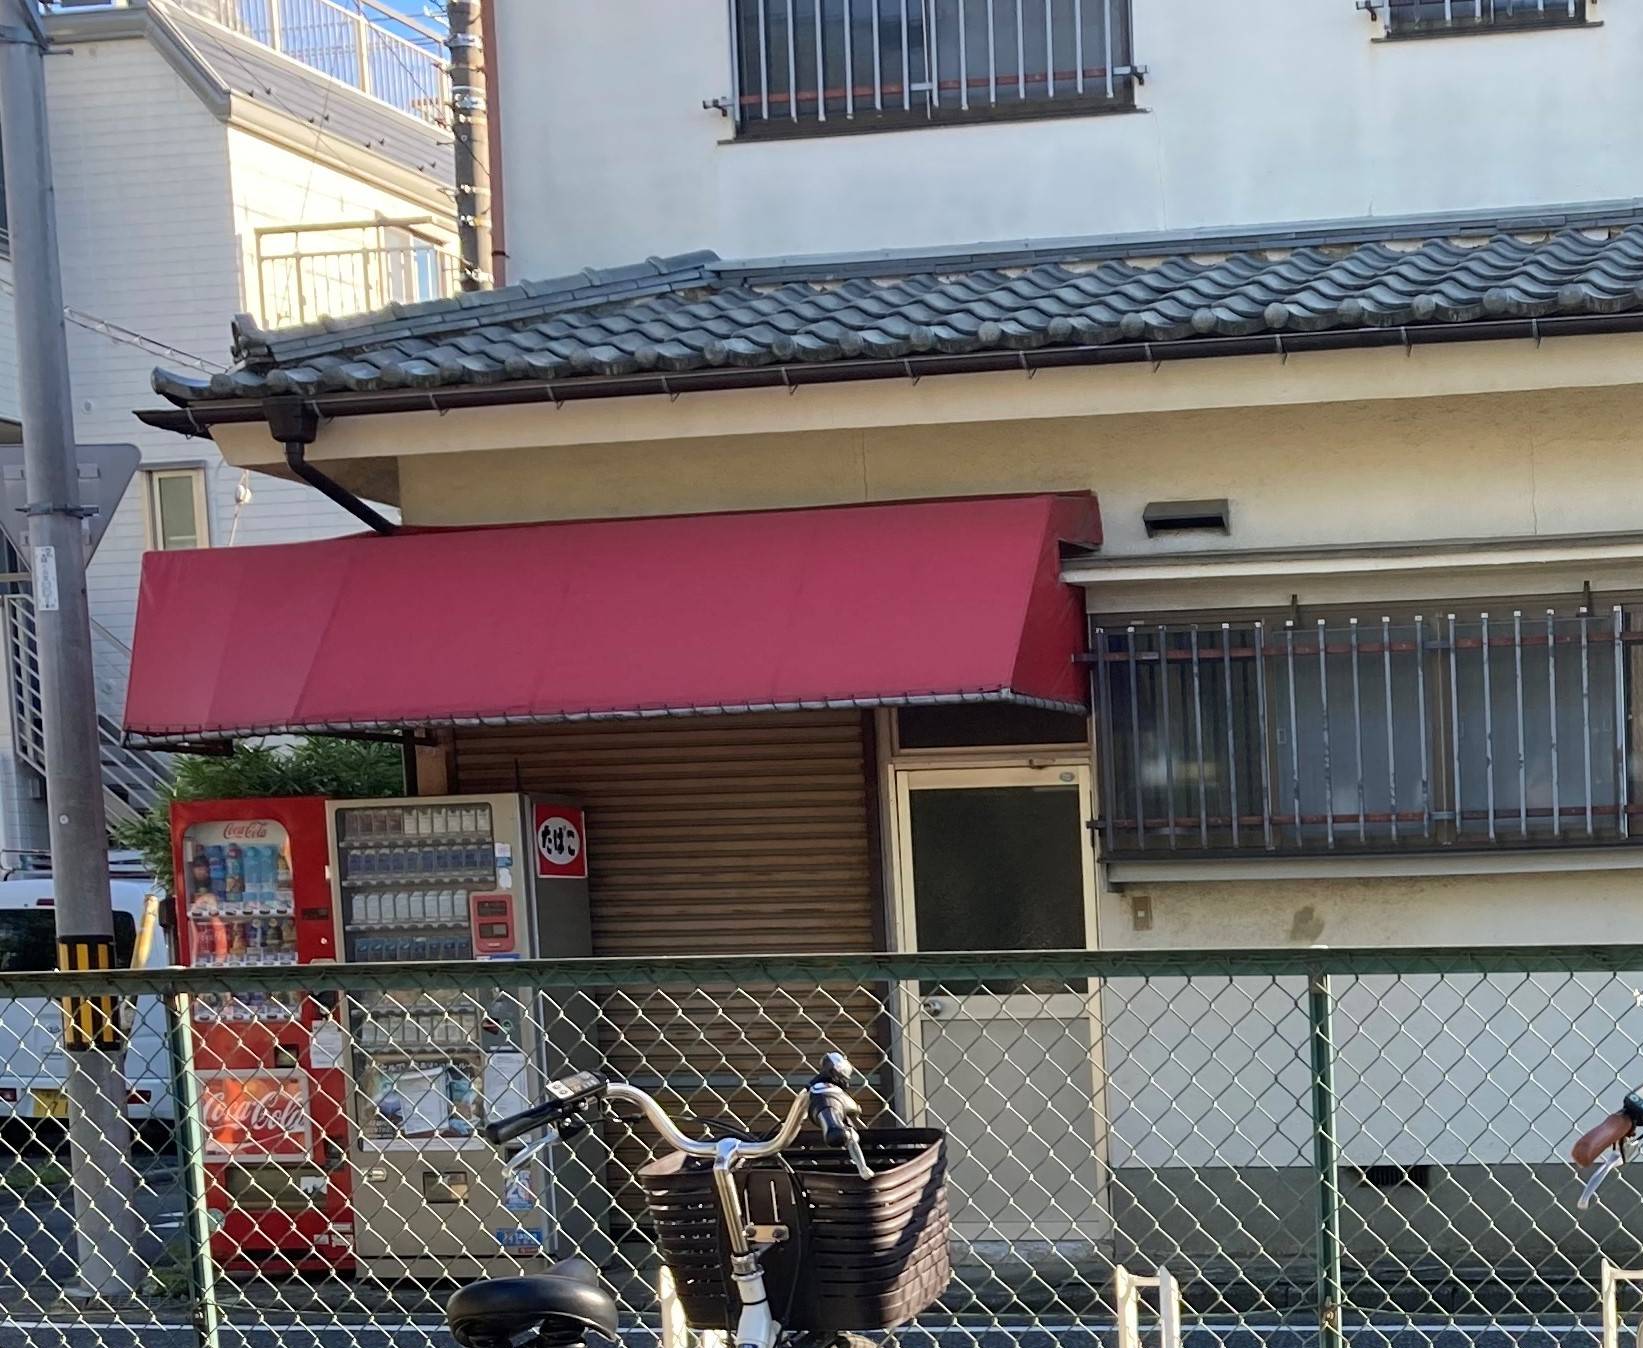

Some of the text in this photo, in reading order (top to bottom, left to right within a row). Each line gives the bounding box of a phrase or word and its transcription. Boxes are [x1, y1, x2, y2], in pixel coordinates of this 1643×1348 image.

[223, 822, 268, 839] Coca-Cola
[541, 825, 576, 856] たばこ
[203, 1088, 308, 1131] Coca-Cola
